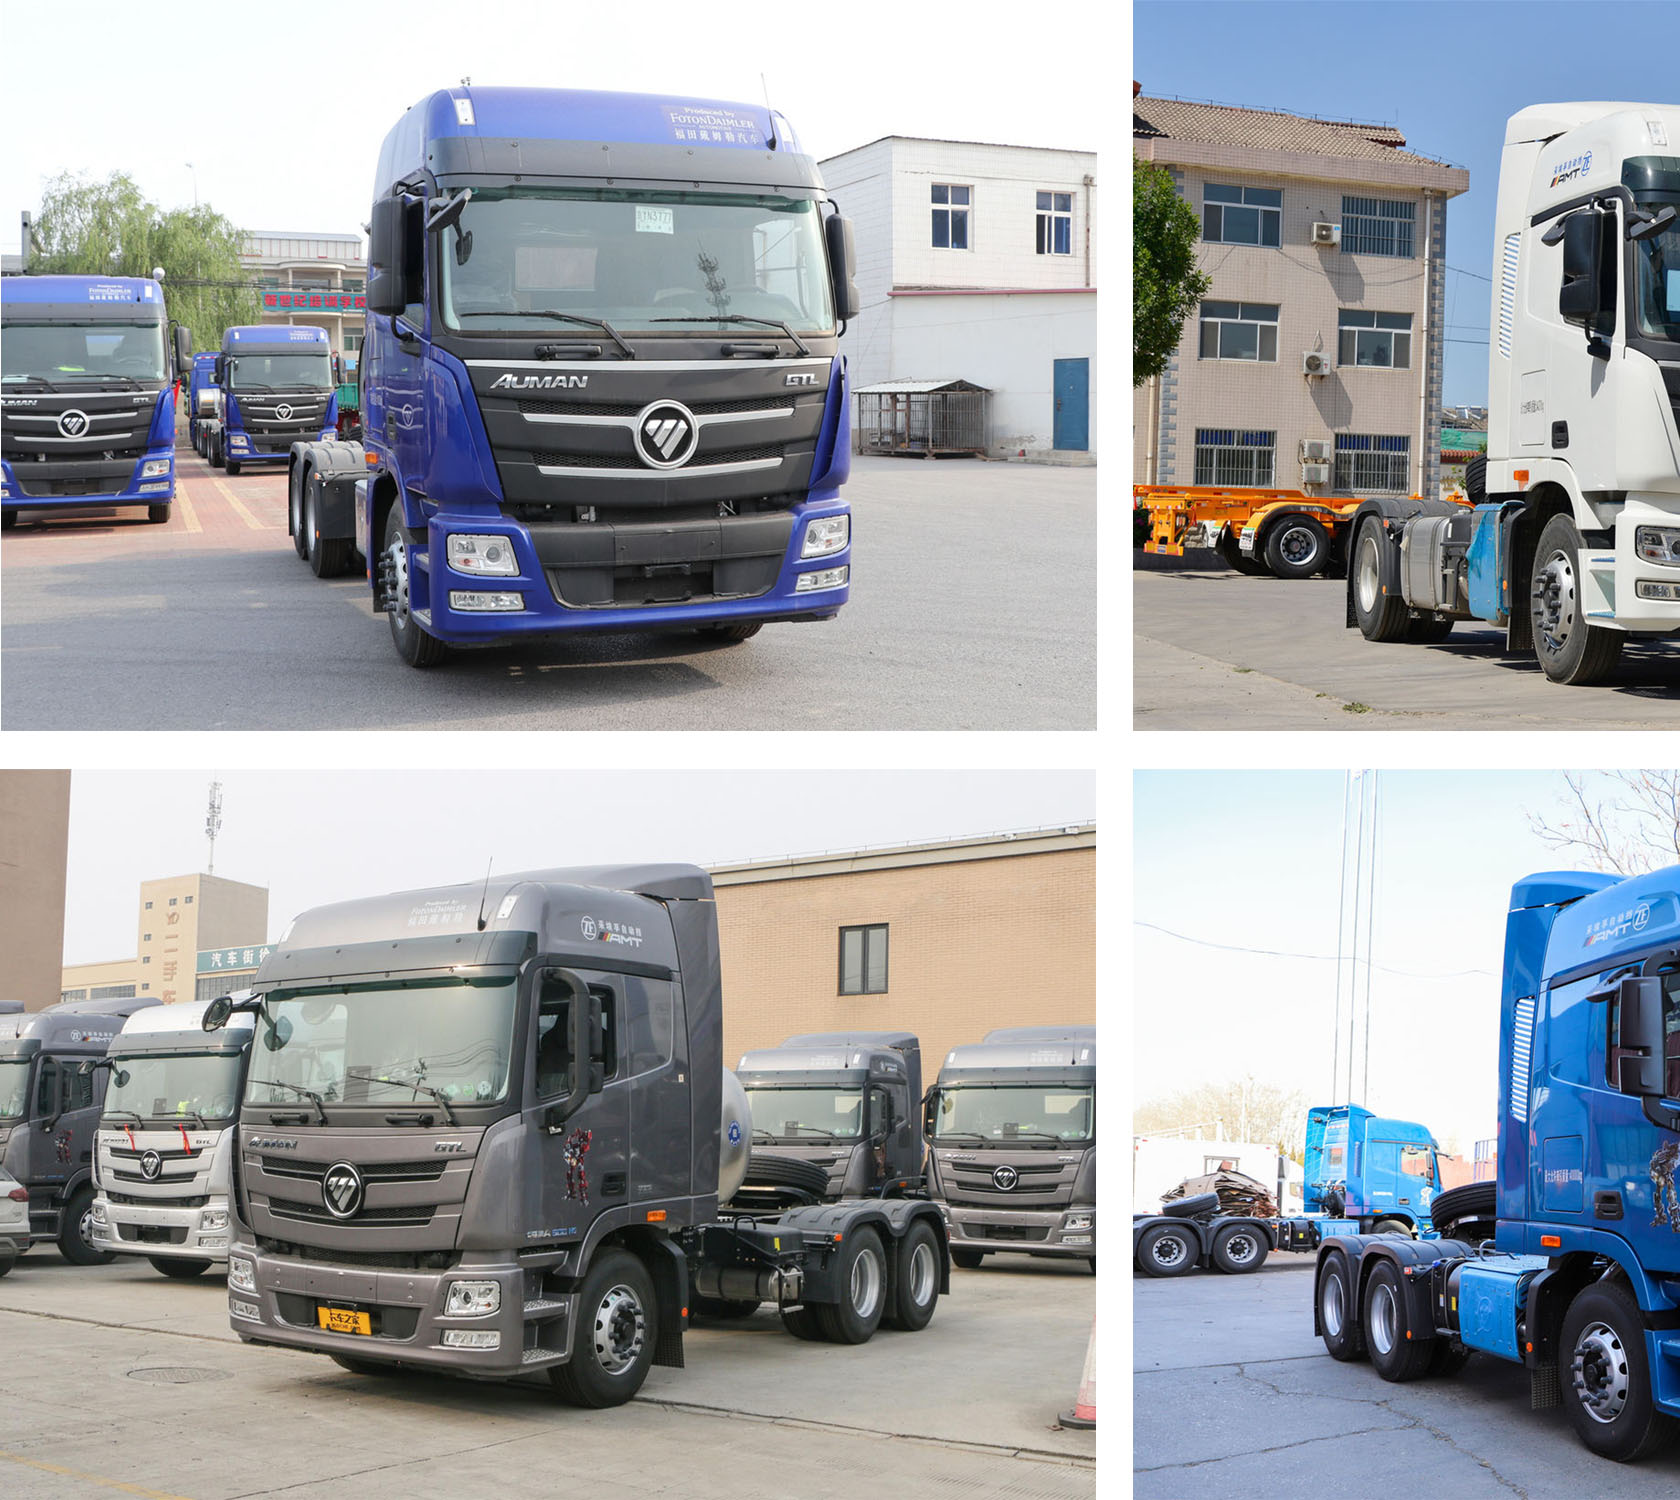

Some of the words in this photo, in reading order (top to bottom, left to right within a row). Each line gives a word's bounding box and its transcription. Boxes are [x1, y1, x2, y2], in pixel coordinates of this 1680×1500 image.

[675, 128, 759, 144] 福田戴姆勒汽车
[265, 294, 367, 308] 新世纪培训学校
[490, 373, 588, 389] AUMAN
[784, 373, 820, 386] GTL
[609, 933, 642, 948] AMT
[1593, 922, 1632, 944] AMT
[434, 1142, 467, 1152] GTL
[330, 1312, 360, 1325] 卡车之家
